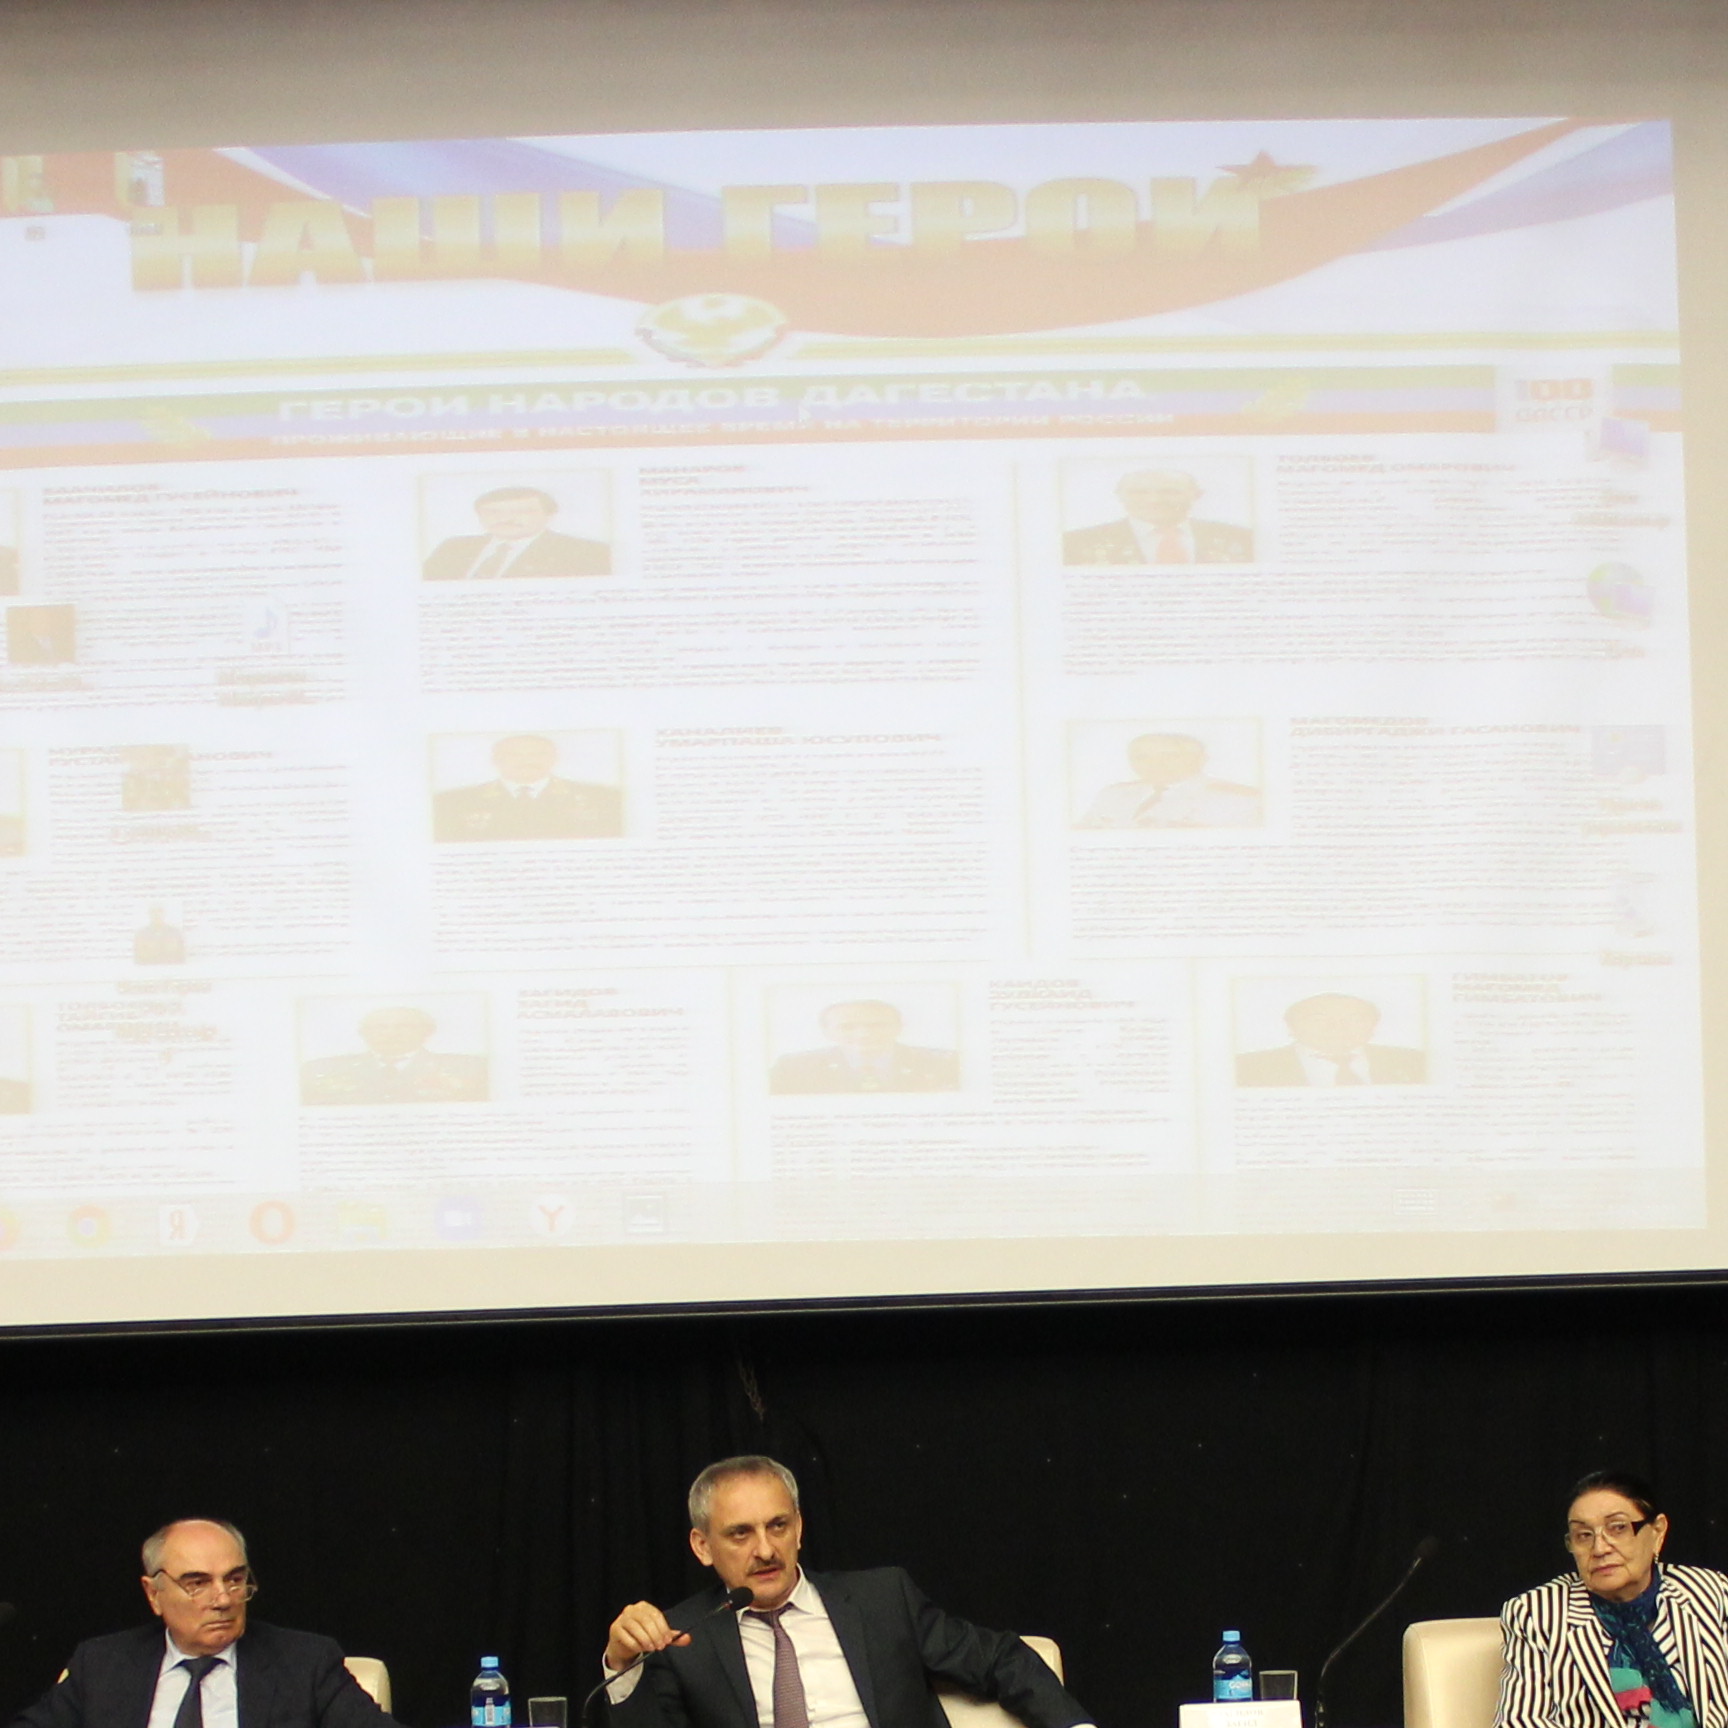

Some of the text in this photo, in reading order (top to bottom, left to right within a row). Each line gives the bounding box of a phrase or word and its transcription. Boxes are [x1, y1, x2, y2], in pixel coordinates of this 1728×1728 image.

[131, 175, 1261, 290] НАШИ ГЕРОИ
[279, 378, 1147, 422] ГЕРОИ НАРОДОВ ДАГЕСТАНА
[272, 428, 502, 445] ПРОЖИВАЮЩИЕ
[538, 423, 711, 438] НАСТОЯЩЕЕ
[825, 418, 862, 429] НА
[873, 415, 1050, 427] ТЕРРИТОРИИ
[1059, 413, 1174, 425] РОССИИ
